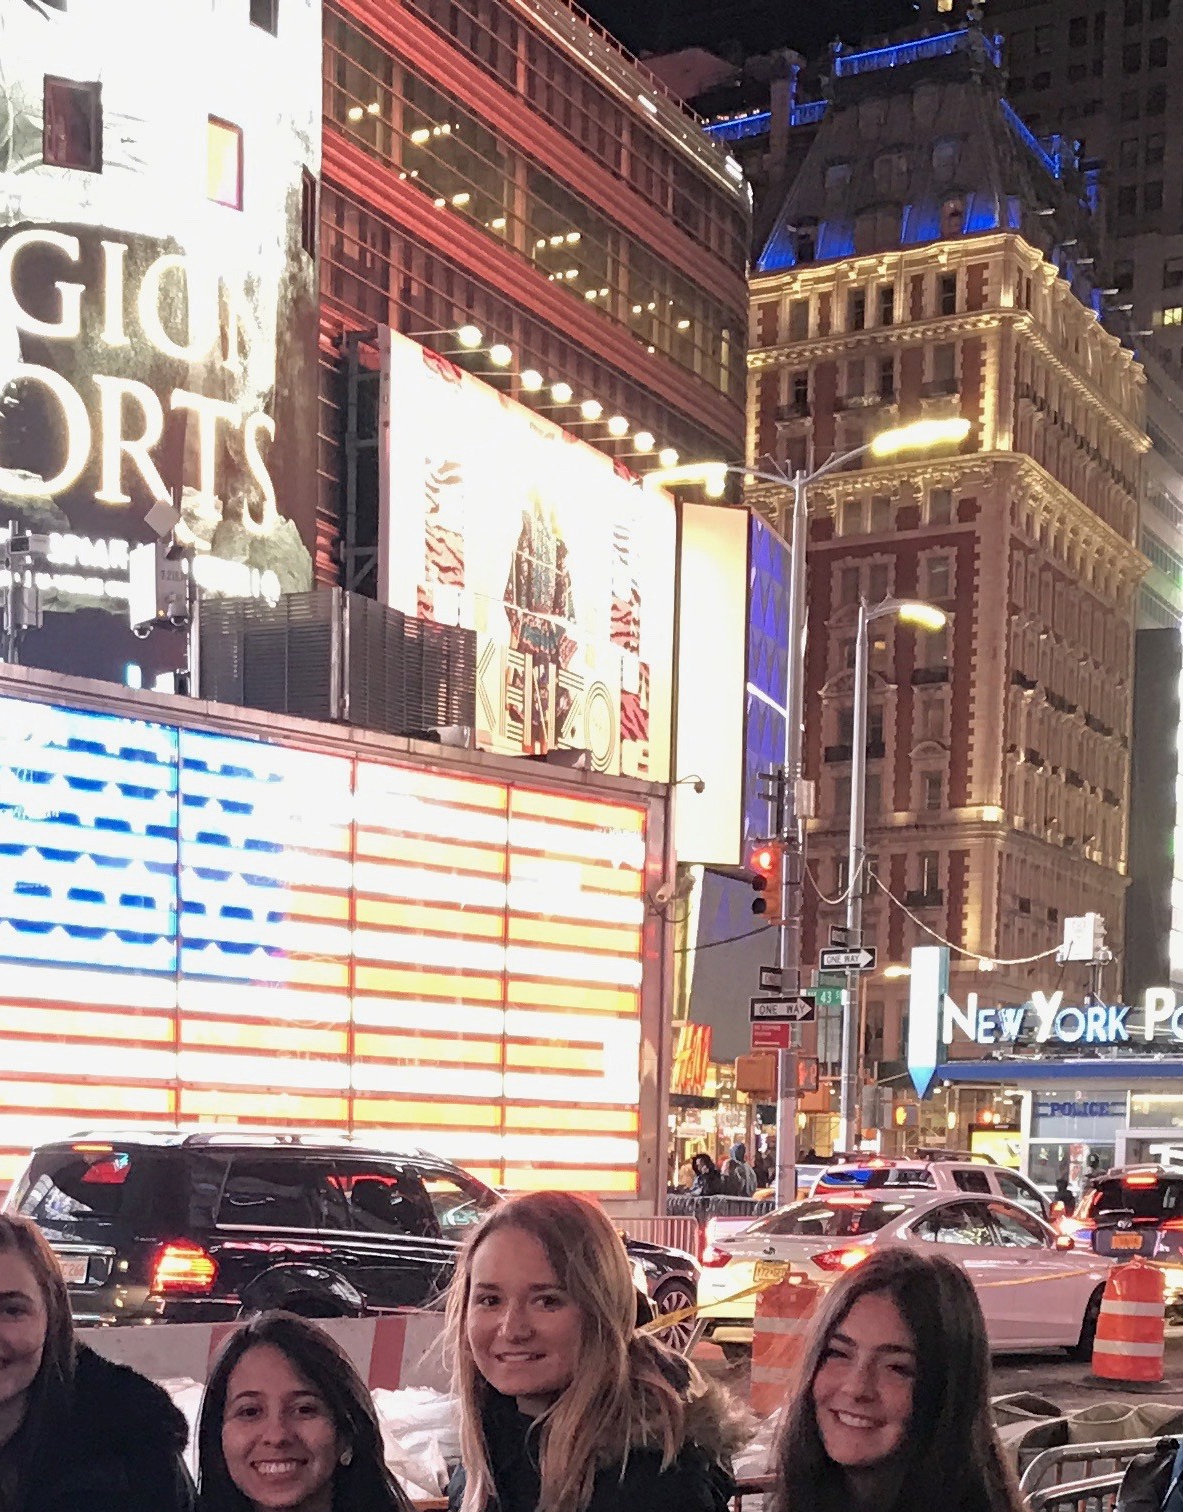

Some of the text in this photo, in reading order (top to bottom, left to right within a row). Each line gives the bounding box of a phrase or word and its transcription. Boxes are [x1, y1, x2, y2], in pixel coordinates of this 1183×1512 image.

[825, 953, 860, 965] ONE WAY
[820, 990, 833, 1004] 43
[758, 1003, 806, 1015] ONE WAY
[942, 991, 1026, 1045] NEW
[1031, 990, 1132, 1044] YORK
[1050, 1101, 1110, 1117] POLICE
